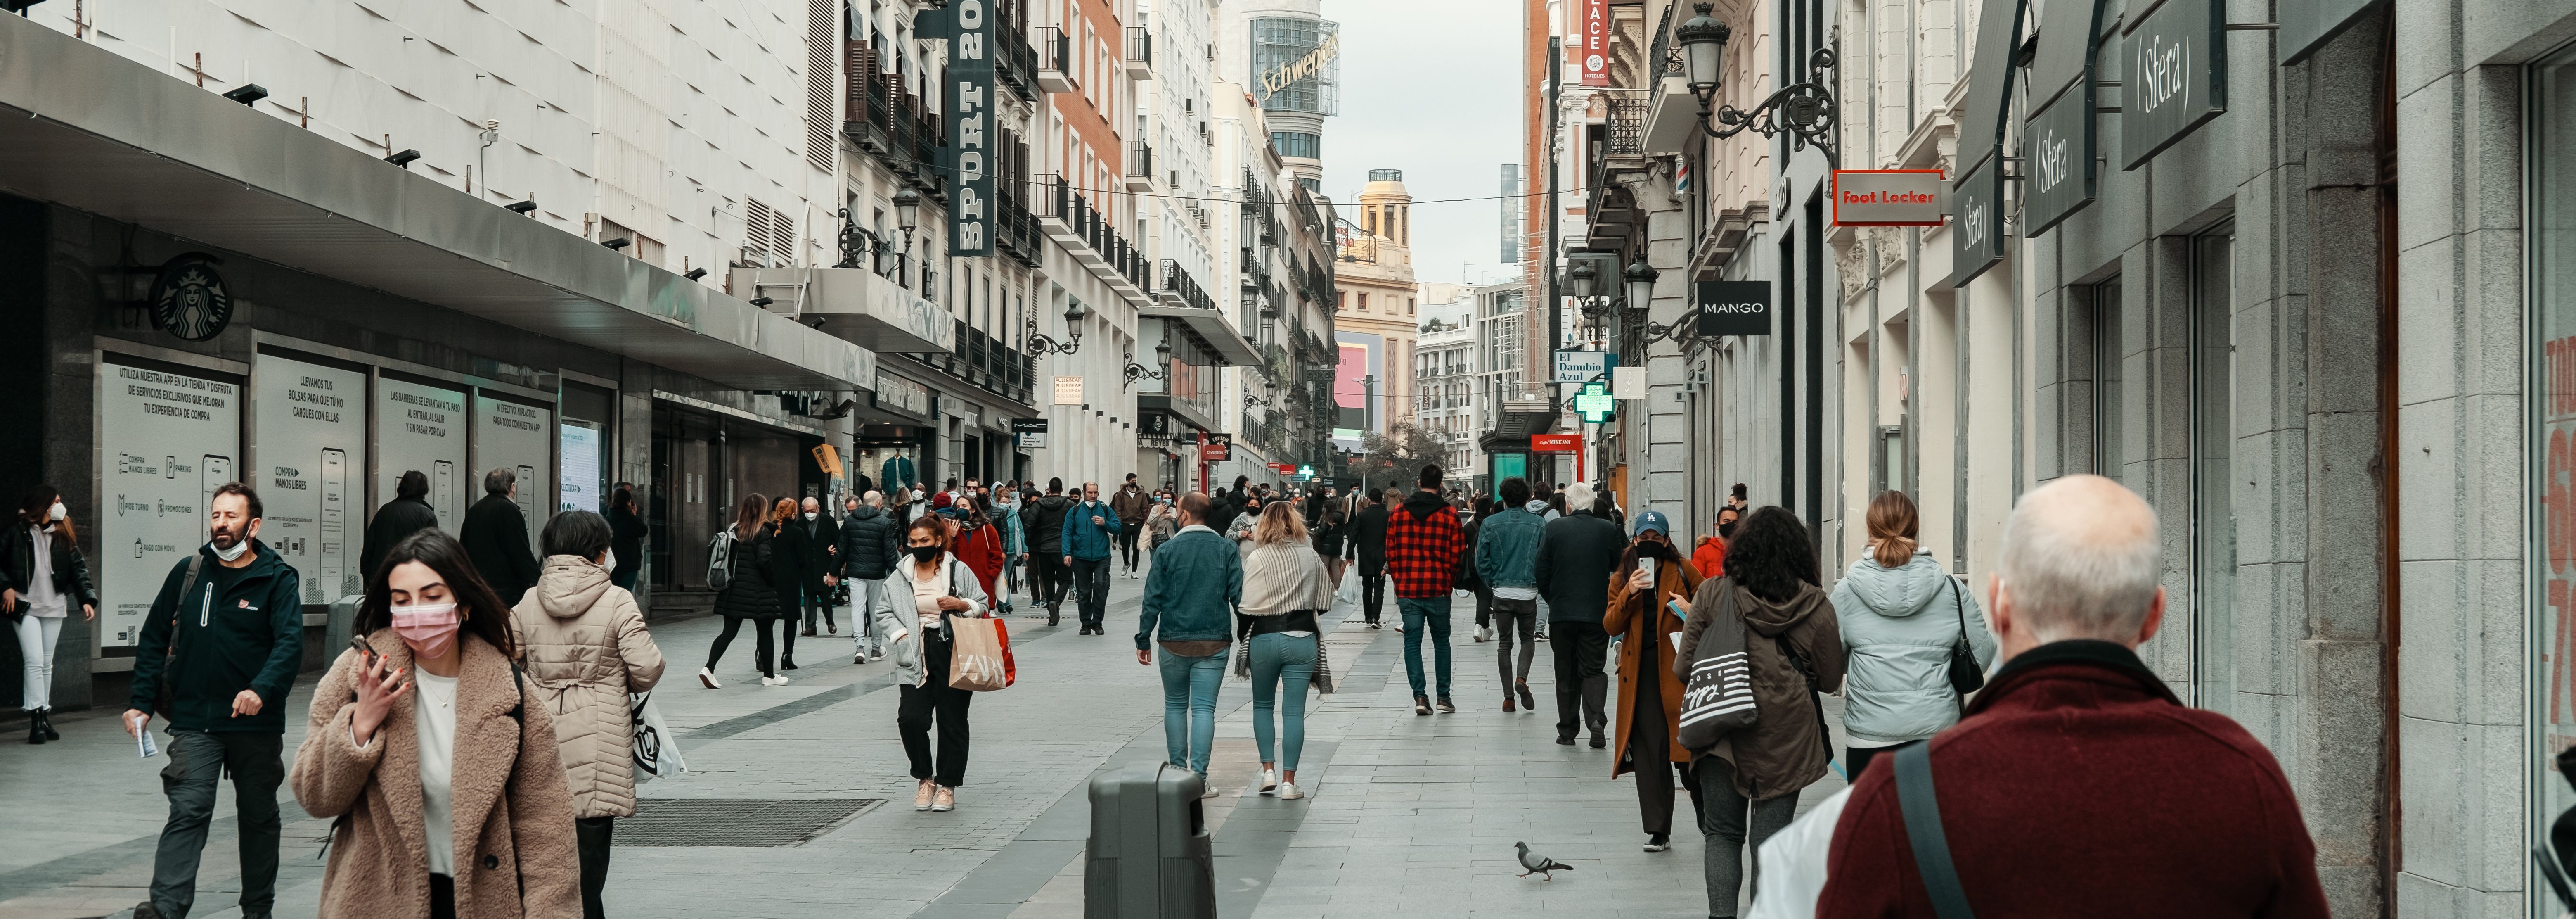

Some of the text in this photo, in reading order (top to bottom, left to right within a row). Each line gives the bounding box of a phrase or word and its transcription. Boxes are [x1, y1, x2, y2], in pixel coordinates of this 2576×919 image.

[1262, 29, 1339, 101] Schweppes
[960, 82, 982, 250] SPORT
[1844, 190, 1935, 204] Foot Locker
[1503, 190, 1517, 240] fnac
[1705, 303, 1764, 313] MANGO
[1559, 353, 1570, 362] El
[1559, 363, 1601, 371] Danubio
[120, 368, 232, 395] UTILIZA NUESTRA APP EN LA TIENDA Y DISFRUTA
[301, 375, 333, 391] LLEVAMOS TUS
[1307, 371, 1335, 380] SHOES
[1559, 372, 1583, 381] Azul
[128, 385, 224, 408] DE SERVICIOS EXCLUSIVOS QUE MEJORAN
[289, 389, 343, 408] BOLSAS PARA QUE TÚ NO
[878, 376, 906, 408] SPORT
[399, 392, 418, 404] BARRERAS
[419, 396, 423, 406] SE
[424, 397, 442, 409] LEVANTAN
[443, 401, 445, 410] A
[446, 402, 450, 411] TU
[451, 403, 460, 413] PASO
[497, 403, 500, 412] NI
[501, 404, 517, 416] EFECTIVO,
[518, 407, 521, 416] NI
[144, 403, 210, 421] TU EXPERIENCIA DE COMPRA
[293, 406, 339, 423] CARGUES CON ELLAS
[408, 409, 445, 423] AL ENTRAR, AL SALIR
[406, 423, 409, 431] Y
[416, 424, 428, 435] PASAR
[437, 427, 445, 437] CAJA
[493, 416, 502, 425] PAGA
[502, 418, 511, 427] TODO
[519, 420, 533, 431] NUESTRA
[819, 454, 829, 469] ONCE
[275, 466, 294, 477] COMPRA
[275, 478, 306, 490] MANOS LIBRES
[165, 505, 191, 513] PROMOCIONES
[1647, 513, 1655, 521] LA
[958, 654, 1006, 684] ZARA
